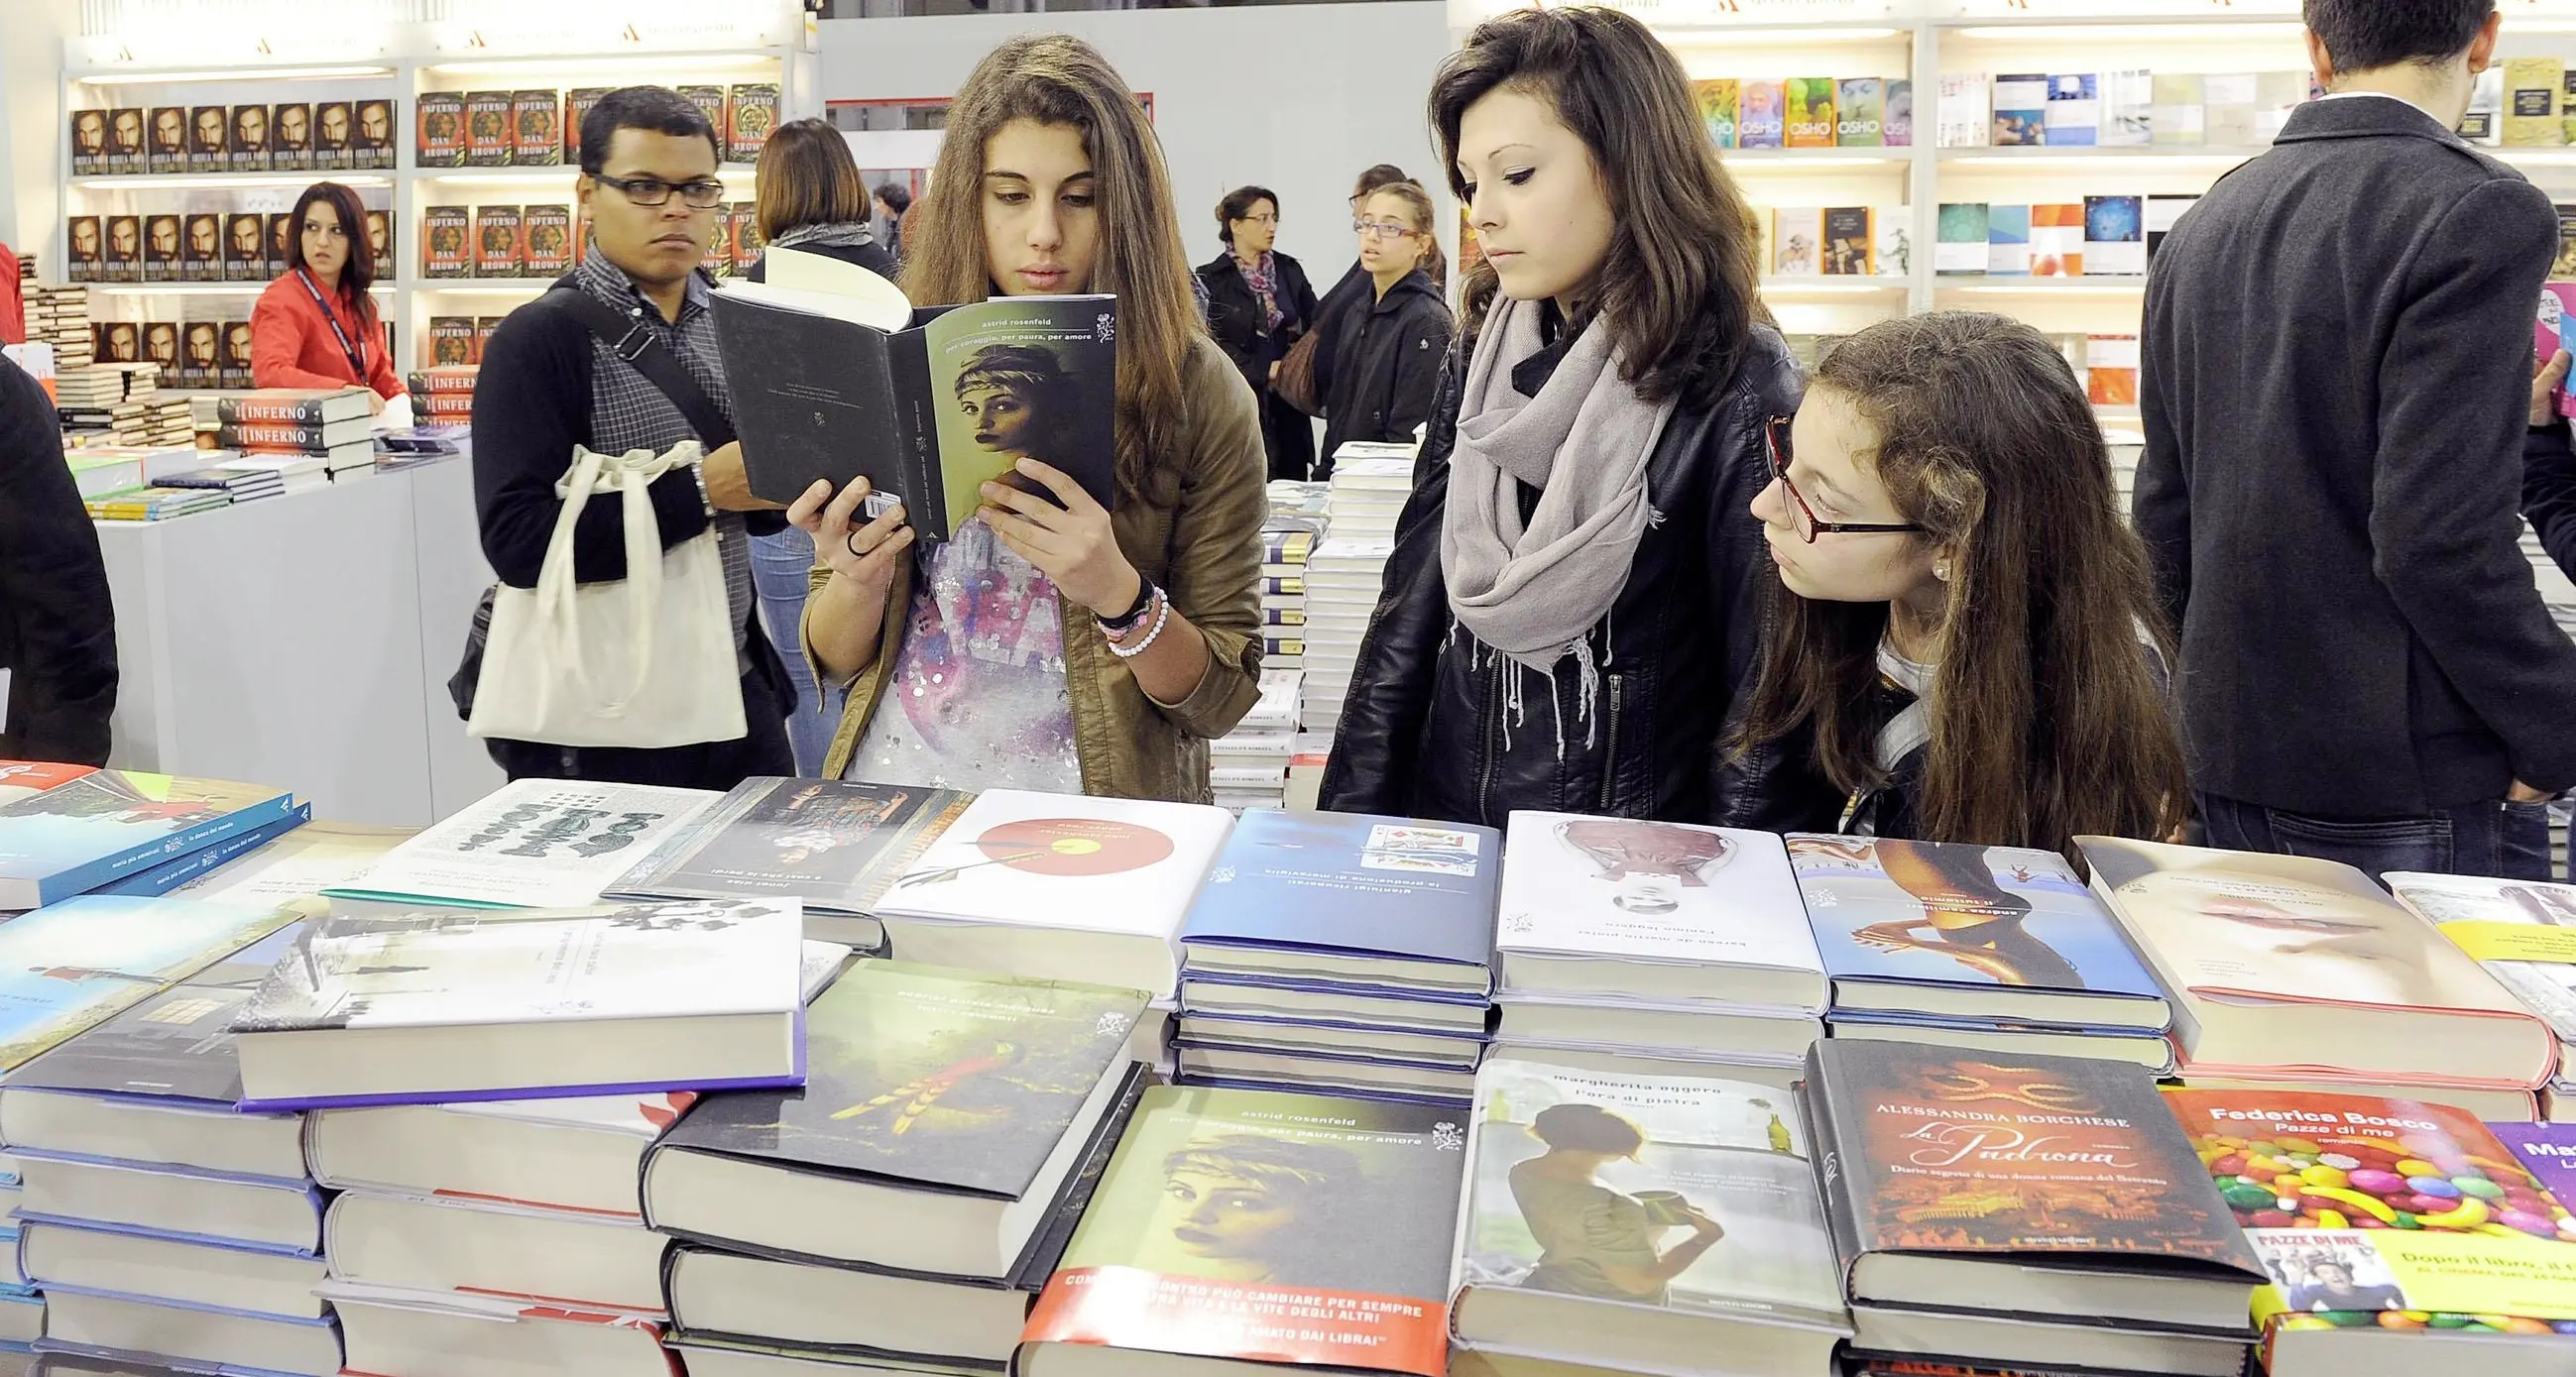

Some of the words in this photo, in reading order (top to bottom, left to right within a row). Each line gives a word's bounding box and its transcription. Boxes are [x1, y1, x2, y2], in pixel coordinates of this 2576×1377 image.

[421, 102, 461, 113] INFERNO
[468, 102, 508, 113] INFERNO
[515, 100, 554, 111] INFERNO
[733, 97, 773, 106] INFERNO
[1740, 120, 1782, 135] OSHO
[1789, 122, 1831, 135] OSHO
[1837, 120, 1880, 134] OSHO
[1884, 122, 1912, 135] OSH
[427, 217, 466, 227] INFERNO
[479, 217, 518, 227] INFERNO
[527, 216, 567, 226] INFERNO
[436, 250, 456, 259] DAN
[487, 250, 507, 259] DAN
[430, 261, 462, 271] BROWN
[481, 261, 514, 271] BROWN
[528, 261, 562, 270] BROWN
[982, 318, 1007, 328] astrid
[431, 328, 472, 338] INFERNO
[434, 378, 478, 389] INFERN
[437, 399, 472, 410] INFER
[248, 406, 306, 420] INFERNO
[250, 430, 306, 443] INFERNO
[1554, 1075, 1653, 1090] margherita
[1241, 1110, 1283, 1120] astrid
[1288, 1114, 1356, 1126] rosenfeld
[1876, 1102, 2009, 1123] ALESSANDRA
[2016, 1113, 2131, 1128] BORGHESE
[2209, 1107, 2337, 1123] Federica
[2349, 1111, 2439, 1132] Bosco
[1900, 1121, 1935, 1141] La
[2275, 1121, 2330, 1134] Pazze
[2335, 1124, 2357, 1136] di
[2362, 1128, 2395, 1139] me
[1297, 1129, 1342, 1141] paura,
[1347, 1134, 1372, 1143] per
[1375, 1136, 1423, 1146] amore
[1909, 1123, 2139, 1168] Padrona
[1890, 1164, 1928, 1175] Diario
[2011, 1172, 2048, 1181] donna
[2095, 1173, 2114, 1182] del
[2401, 1252, 2460, 1264] Dopo
[2466, 1255, 2480, 1265] il
[2547, 1262, 2561, 1271] il
[1212, 1287, 1243, 1300] PUÒ
[1246, 1290, 1325, 1308] CAMBIARE
[1328, 1298, 1358, 1312] PER
[1361, 1301, 1423, 1318] SEMPRE
[1254, 1302, 1285, 1317] VITE
[1290, 1306, 1334, 1320] DEGLI
[1339, 1310, 1380, 1323] ALTRI
[1300, 1329, 1325, 1342] DAI
